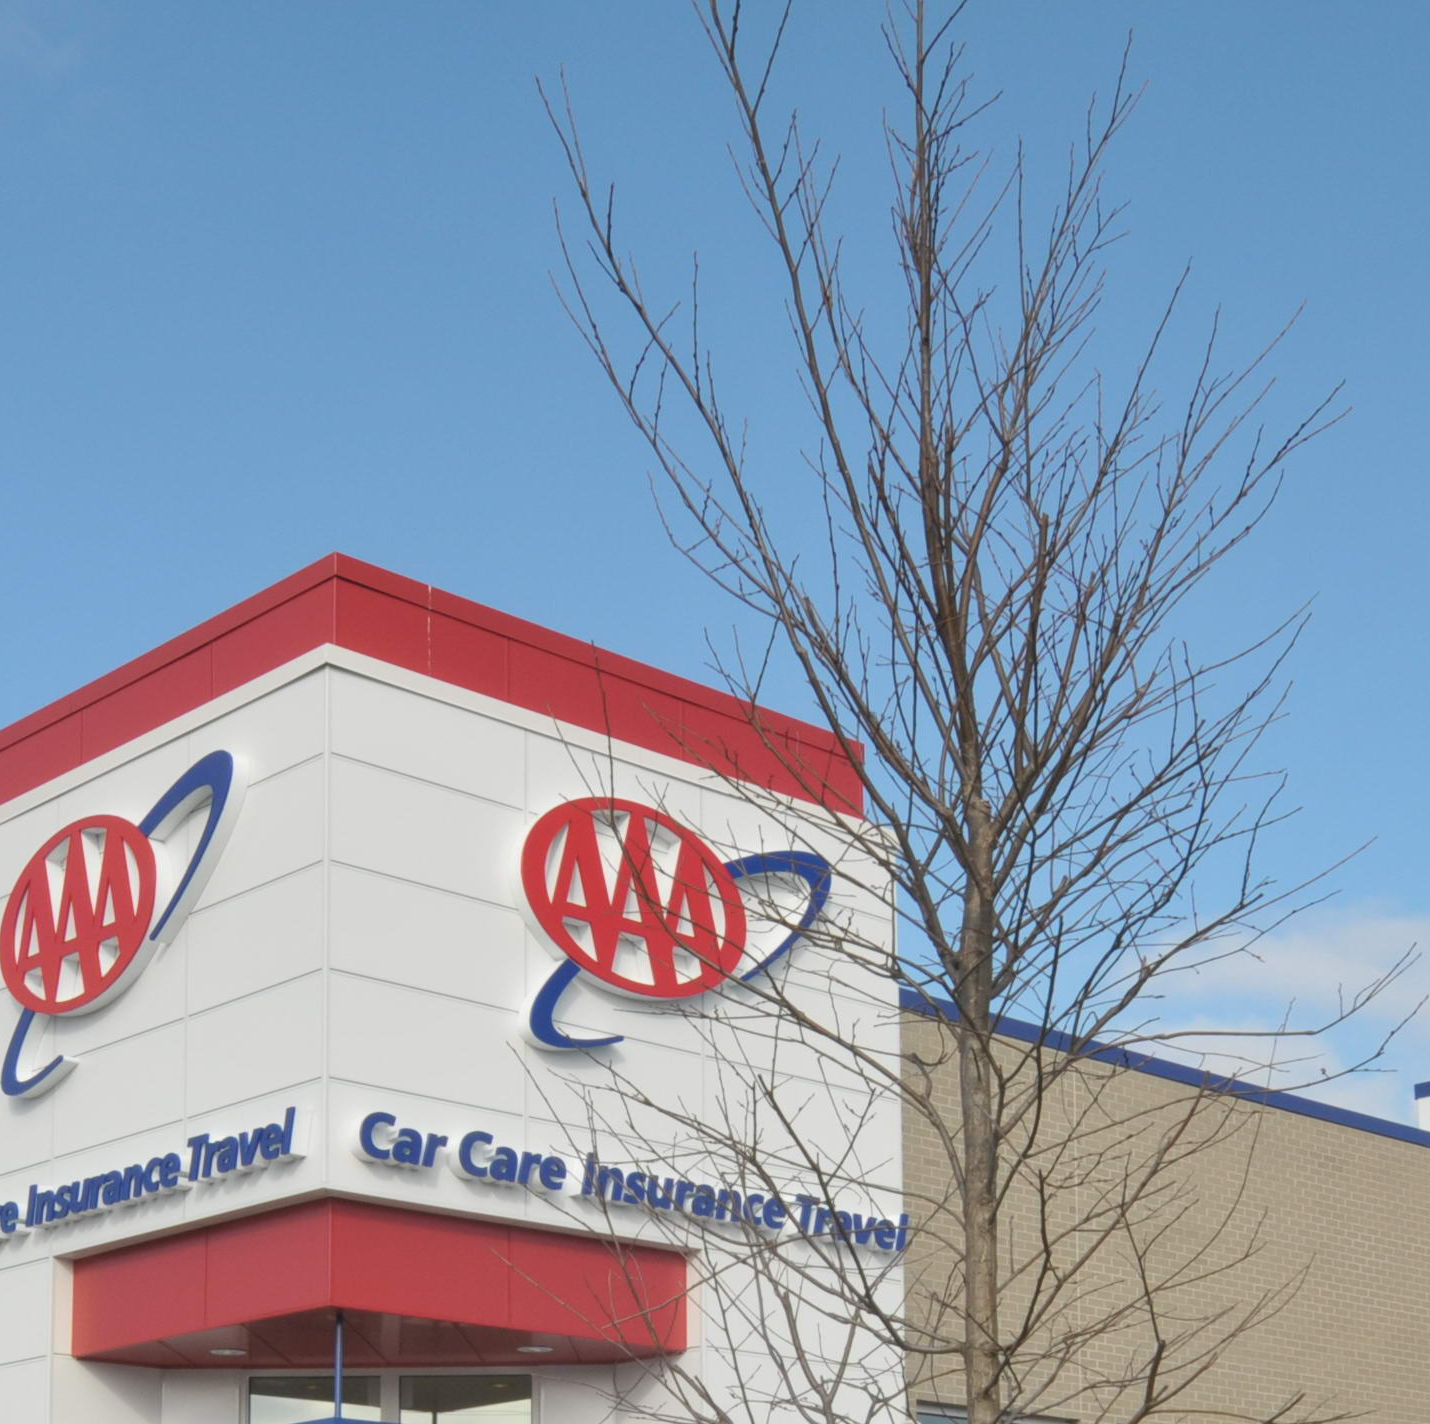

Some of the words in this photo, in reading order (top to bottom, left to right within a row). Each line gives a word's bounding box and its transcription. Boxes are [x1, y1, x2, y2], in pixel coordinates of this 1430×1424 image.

[0, 815, 157, 1016] AAA
[521, 797, 747, 998] AAA
[25, 1152, 182, 1227] Insurance
[187, 1106, 296, 1182] Travel
[359, 1111, 448, 1168] Car
[458, 1131, 567, 1191] Care
[581, 1152, 786, 1230] Insurance
[796, 1193, 909, 1251] Travel
